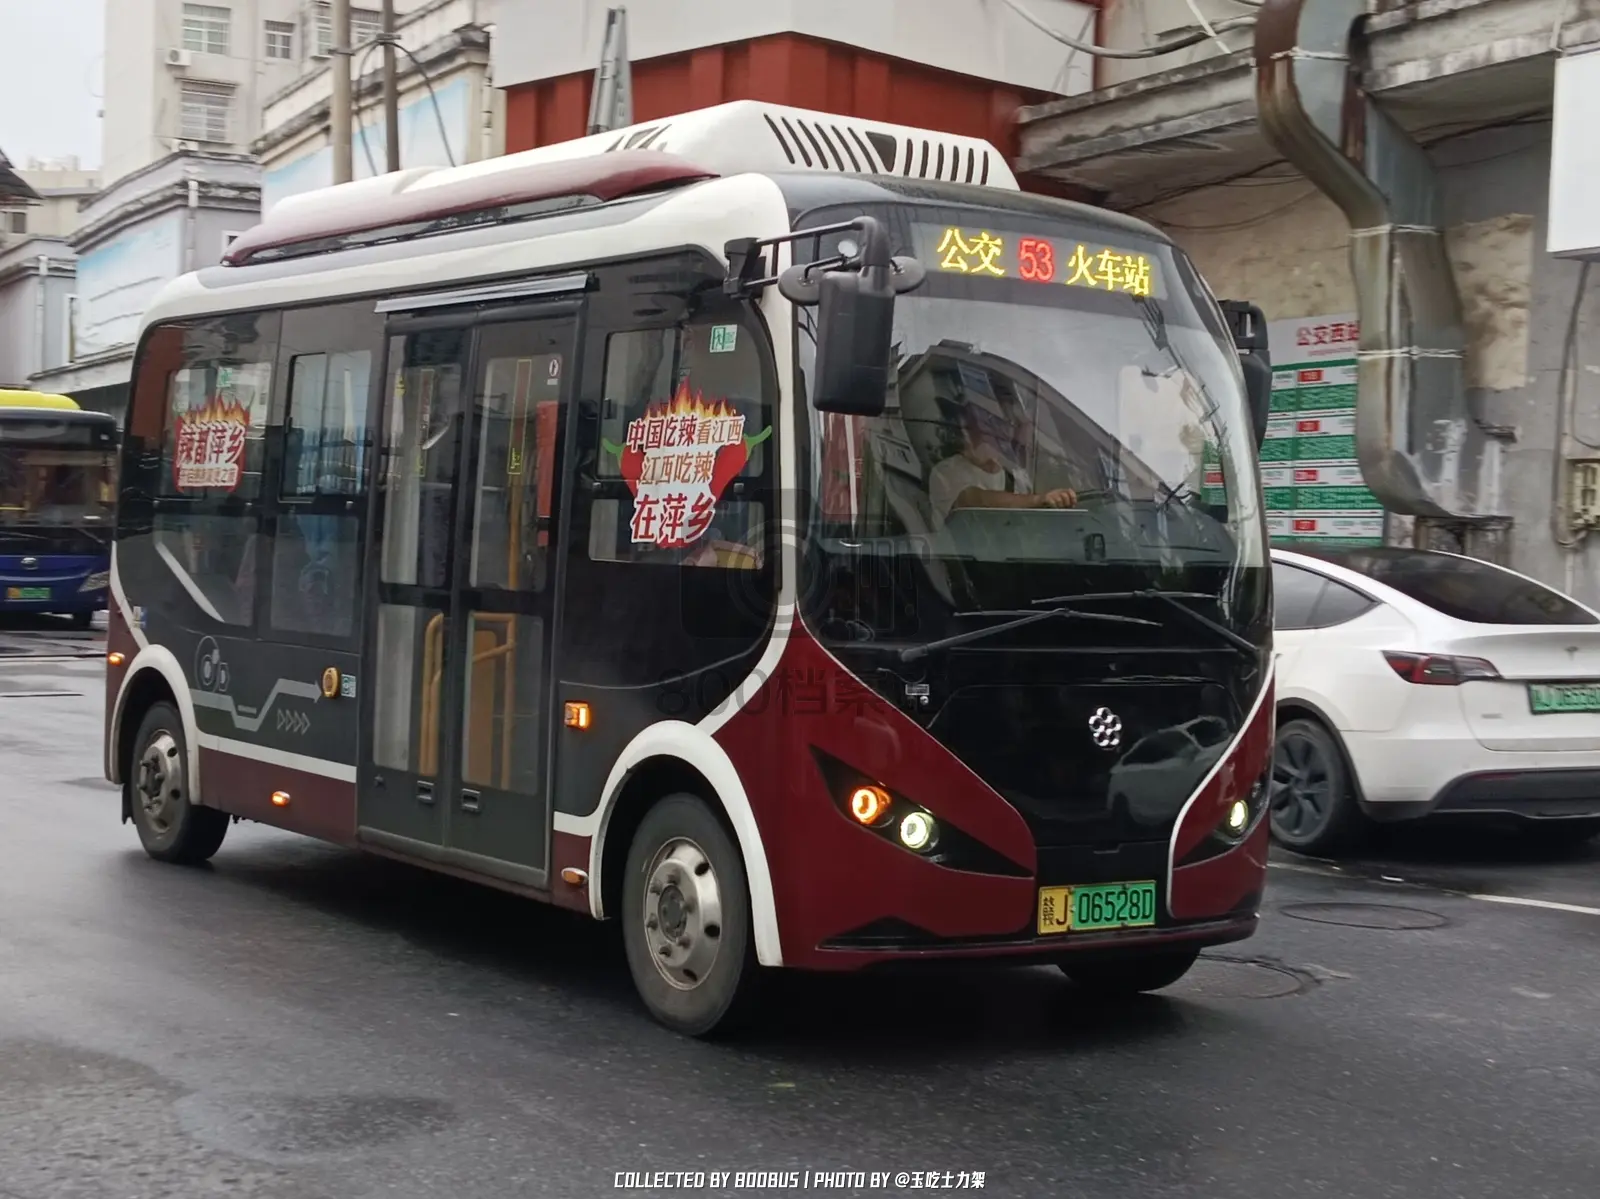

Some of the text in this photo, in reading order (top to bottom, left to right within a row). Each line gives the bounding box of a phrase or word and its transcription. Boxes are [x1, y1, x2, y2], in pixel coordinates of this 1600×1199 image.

[937, 228, 1149, 295] 公交 53 火车站
[640, 452, 714, 485] 江西吃辣
[632, 494, 715, 540] 在萍乡
